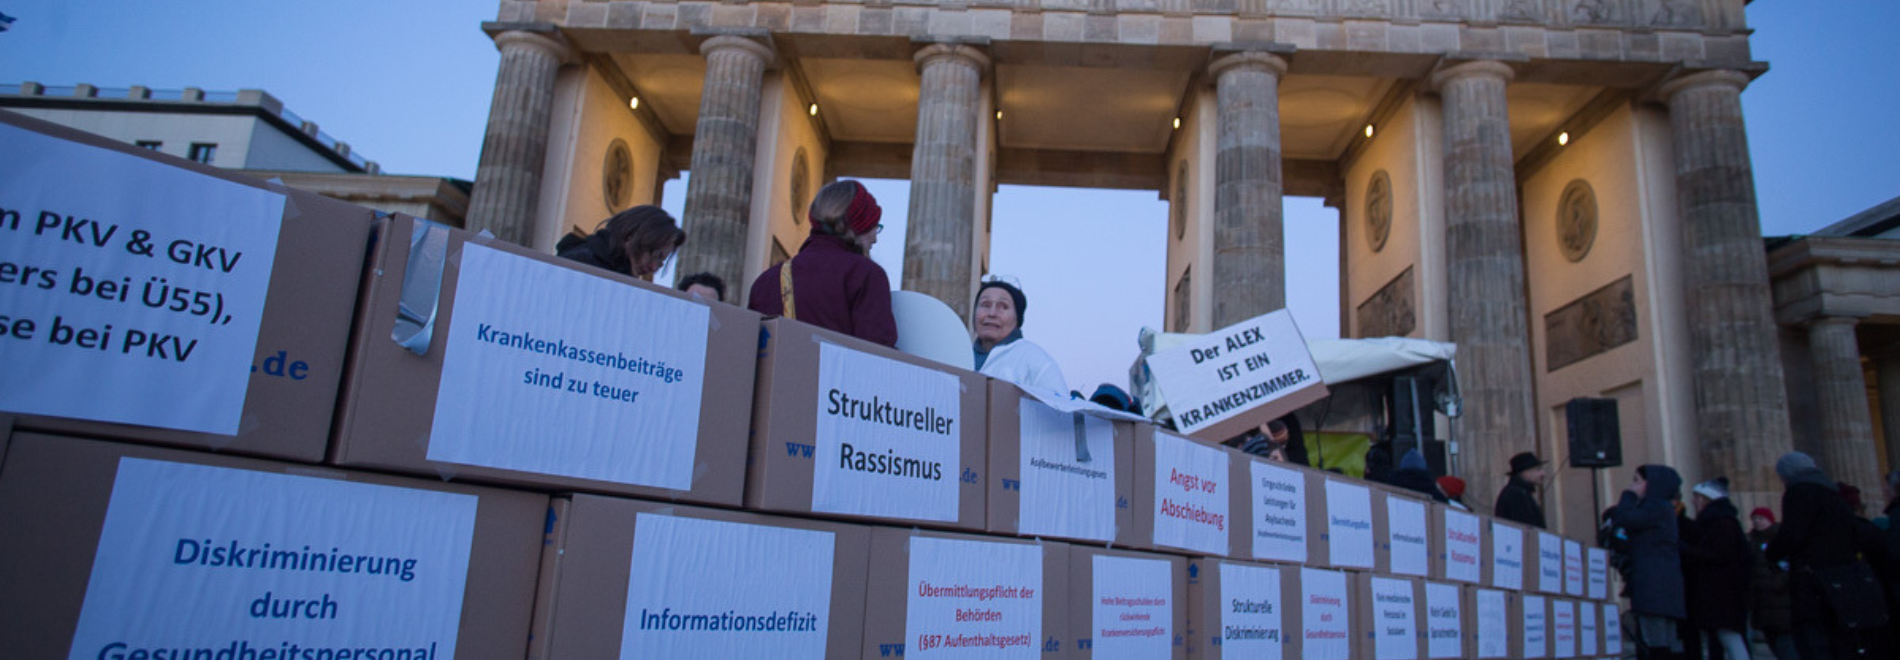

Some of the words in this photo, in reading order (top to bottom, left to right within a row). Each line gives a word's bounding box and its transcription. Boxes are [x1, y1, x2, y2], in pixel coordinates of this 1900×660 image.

[35, 210, 118, 247] PKV
[126, 230, 154, 257] &
[167, 239, 242, 272] GKV
[69, 267, 131, 302] bei
[142, 276, 232, 326] Ü55),
[49, 316, 112, 350] bei
[122, 329, 197, 362] PKV
[477, 323, 684, 383] Krankenkassenbeiträge
[1190, 346, 1220, 364] Der
[1225, 327, 1266, 352] ALEX
[1217, 363, 1240, 381] IST
[1245, 352, 1271, 372] EIN
[523, 368, 564, 389] sind
[567, 379, 588, 394] zu
[593, 380, 639, 403] teuer
[1180, 369, 1310, 427] KRANKENZIMMER.
[827, 388, 953, 436] Struktureller
[840, 442, 942, 481] Rassismus
[1170, 467, 1199, 492] Angst
[1201, 479, 1216, 494] vor
[1161, 498, 1224, 531] Abschiebung
[173, 538, 417, 582] Diskriminierung
[249, 592, 338, 619] durch
[919, 581, 1018, 601] Übermittlungspflicht
[1019, 586, 1034, 598] der
[1232, 599, 1272, 614] Strukturelle
[640, 608, 817, 632] Informationsdefizit
[955, 608, 1002, 622] Behörden
[918, 634, 941, 651] (§87
[944, 633, 1031, 649] Aufenthaltsgesetz)
[1225, 625, 1279, 643] Diskriminierung
